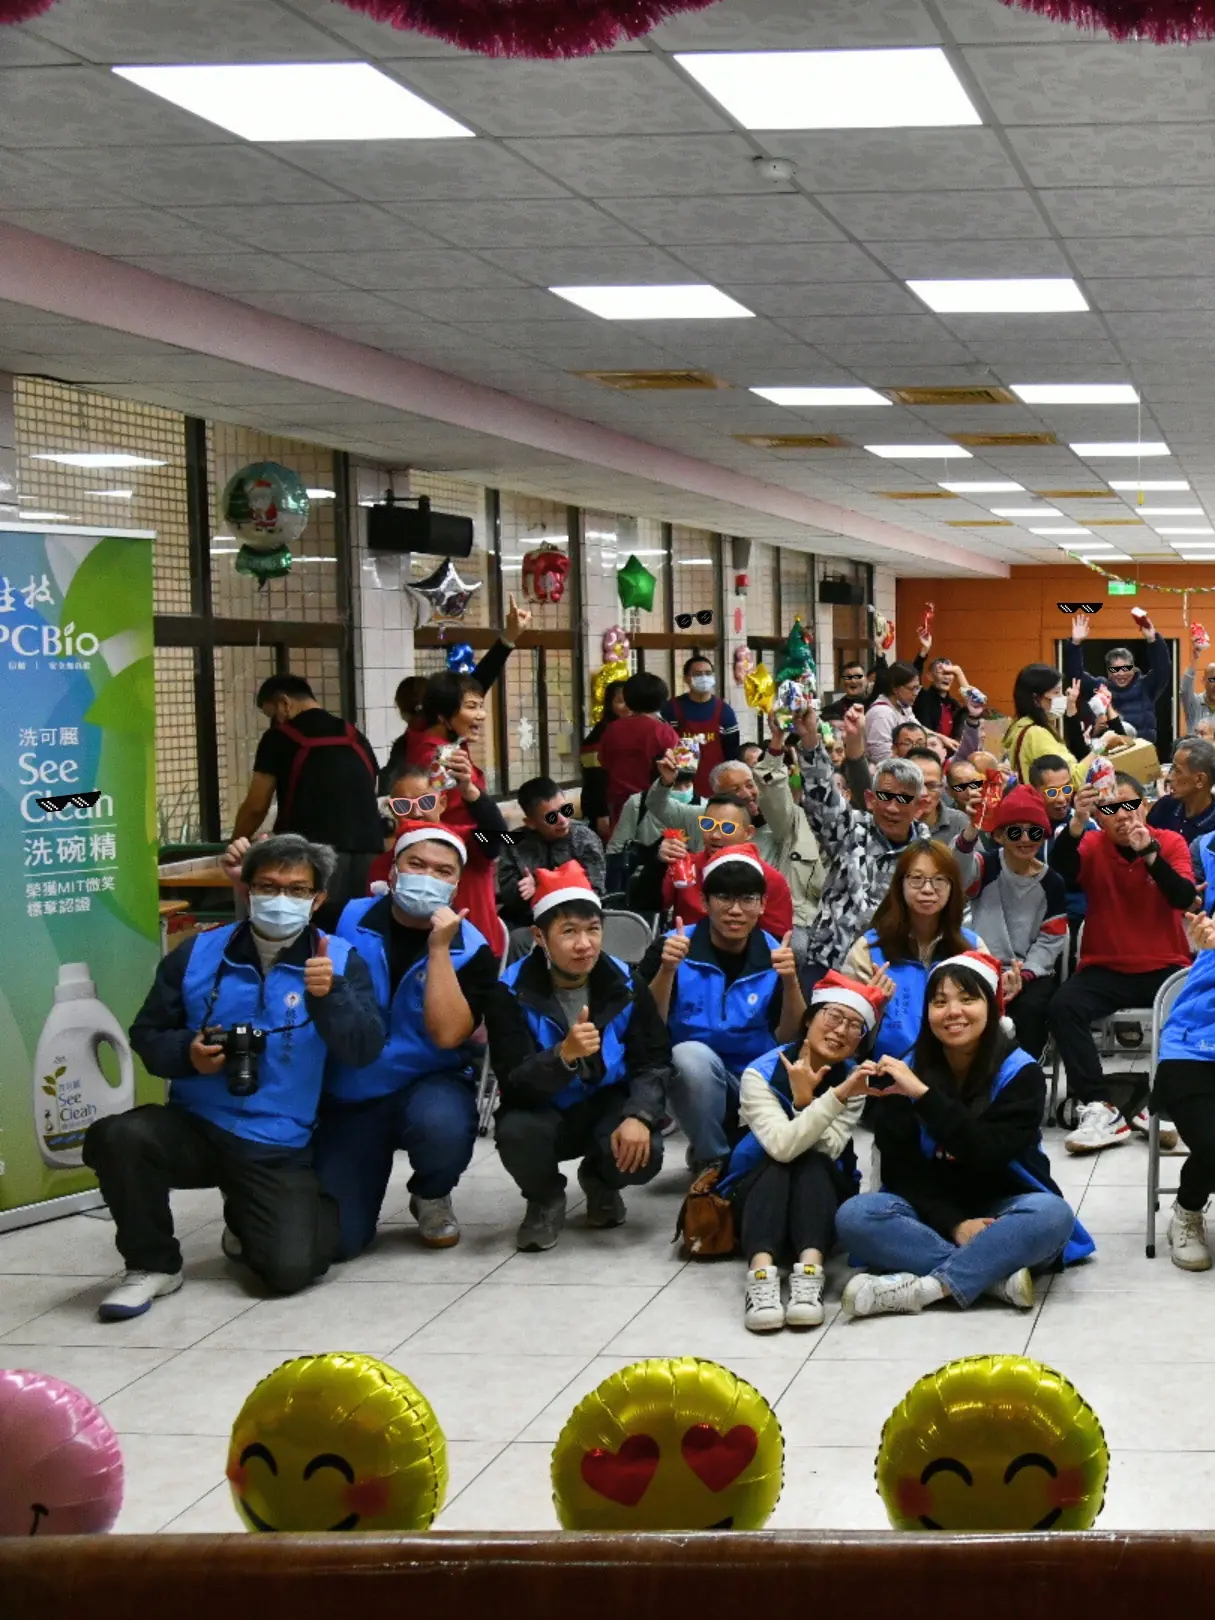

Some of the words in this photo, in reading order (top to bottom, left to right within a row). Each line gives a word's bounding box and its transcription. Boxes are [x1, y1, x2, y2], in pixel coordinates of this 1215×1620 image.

[19, 727, 79, 746] 洗可麗
[18, 752, 79, 785] See
[24, 832, 117, 867] 洗碗精
[58, 1093, 82, 1107] See
[60, 1103, 97, 1122] Clean
